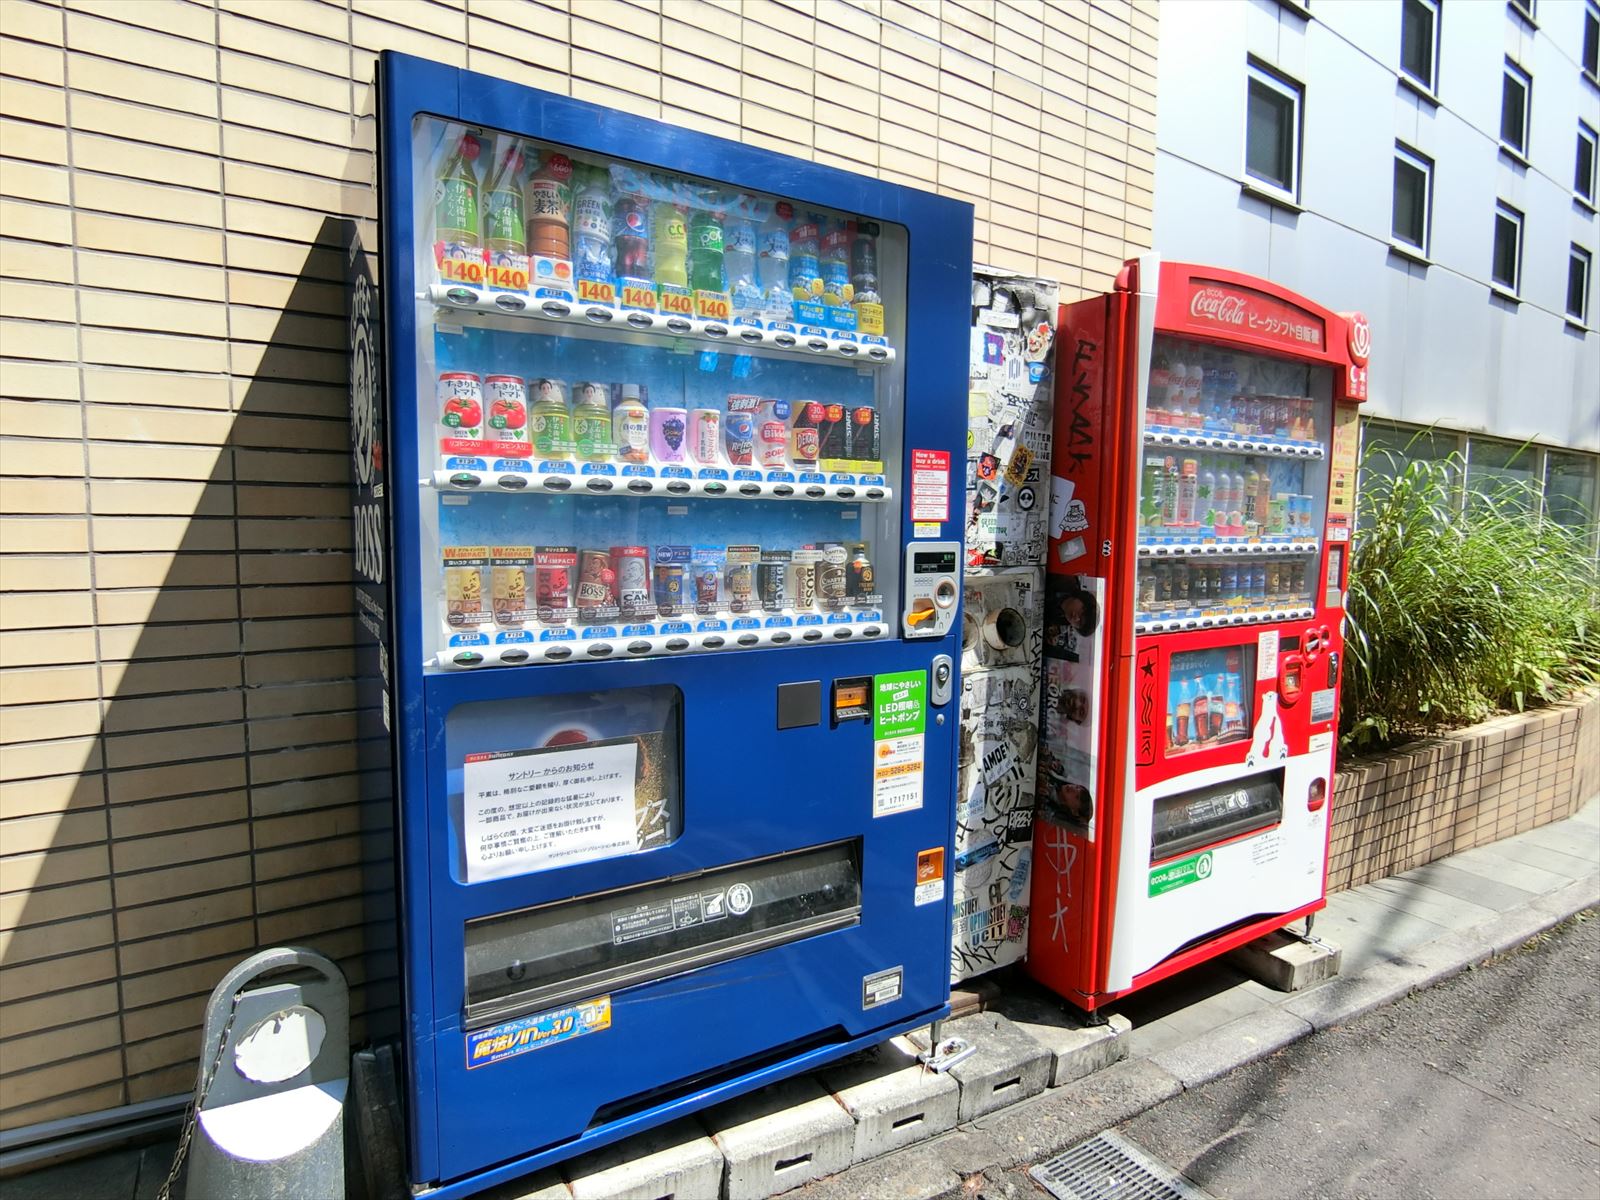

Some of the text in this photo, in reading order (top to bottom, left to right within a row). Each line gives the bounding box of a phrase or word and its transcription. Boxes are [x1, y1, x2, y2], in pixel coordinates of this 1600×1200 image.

[533, 189, 558, 199] やさしい
[534, 199, 559, 215] 麦茶
[454, 388, 476, 397] トマト
[499, 390, 521, 399] トマト
[354, 503, 382, 584] BOSS
[581, 585, 604, 597] BOSS
[806, 568, 814, 607] BOSS
[880, 710, 920, 725] ヒートポンプ
[508, 762, 595, 781] サントリー からのお知らせ
[889, 791, 918, 804] 1717151
